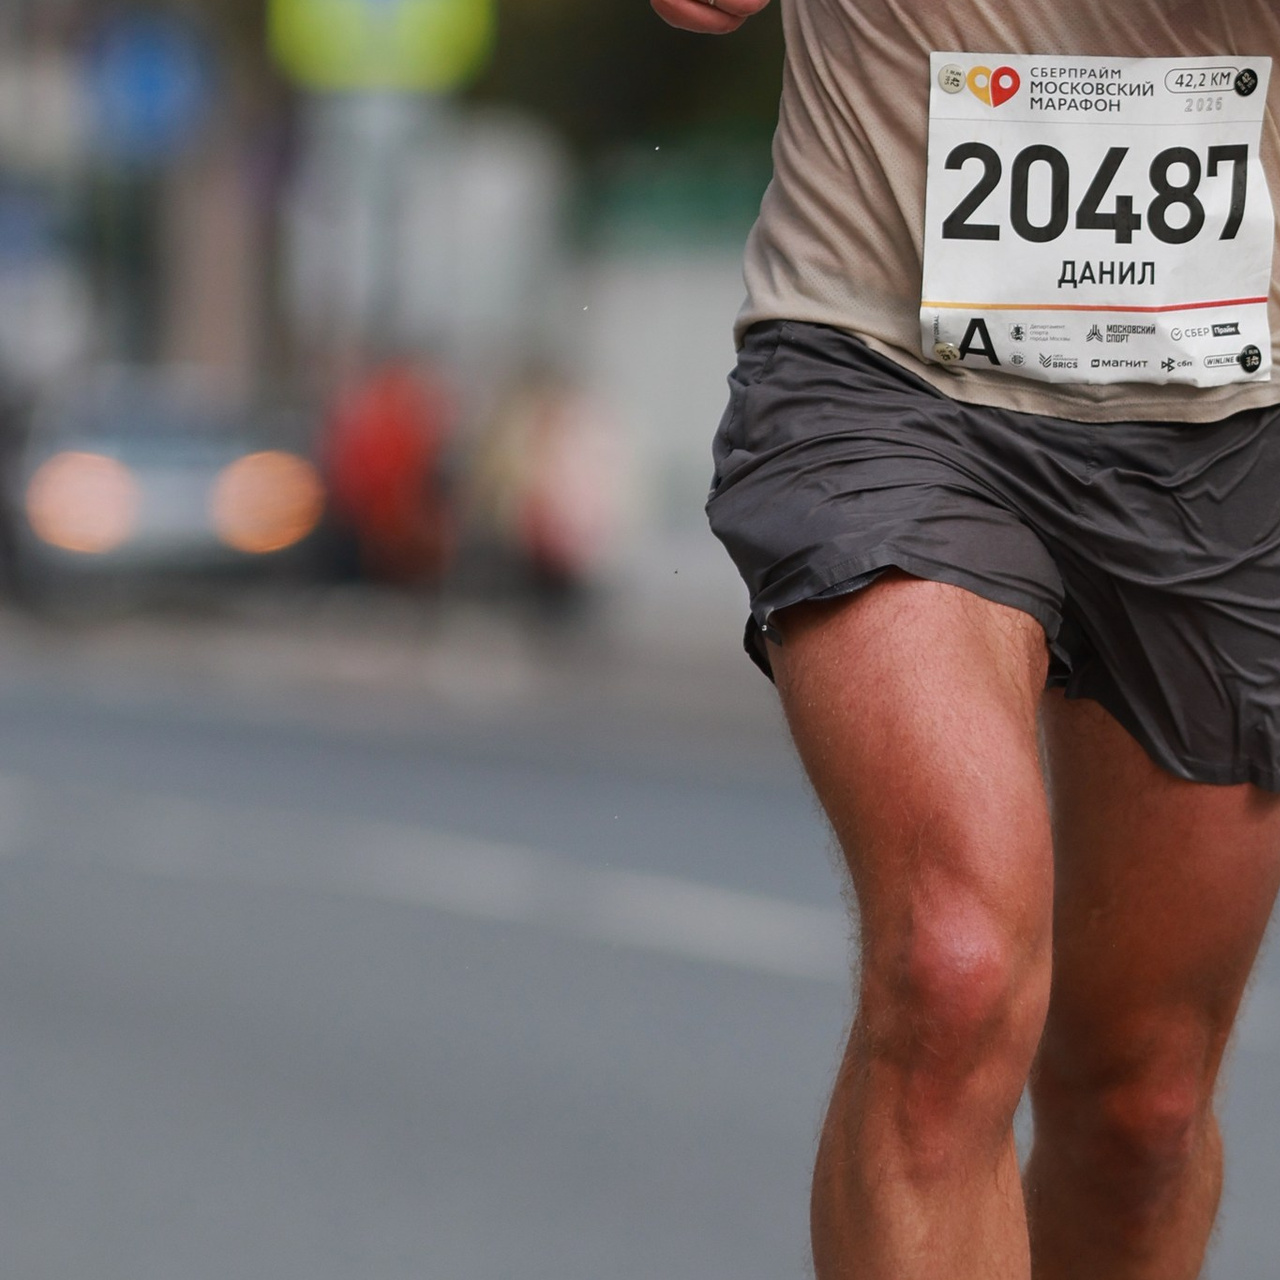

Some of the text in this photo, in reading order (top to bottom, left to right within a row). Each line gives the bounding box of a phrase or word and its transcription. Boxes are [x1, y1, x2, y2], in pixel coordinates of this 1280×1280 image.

[1030, 67, 1121, 79] СБЕРПРАЙМ
[1175, 73, 1206, 89] 42,2
[1030, 81, 1154, 96] МОСКОВСКИЙ
[1030, 97, 1121, 112] МАРАФОН
[941, 142, 1249, 245] 20487
[1057, 260, 1156, 289] ДАНИЛ
[1106, 323, 1156, 334] МОСКОВСКИЙ
[1184, 327, 1210, 338] СБЕР
[1106, 333, 1129, 343] СПОРТ
[1207, 356, 1235, 365] WINLINE
